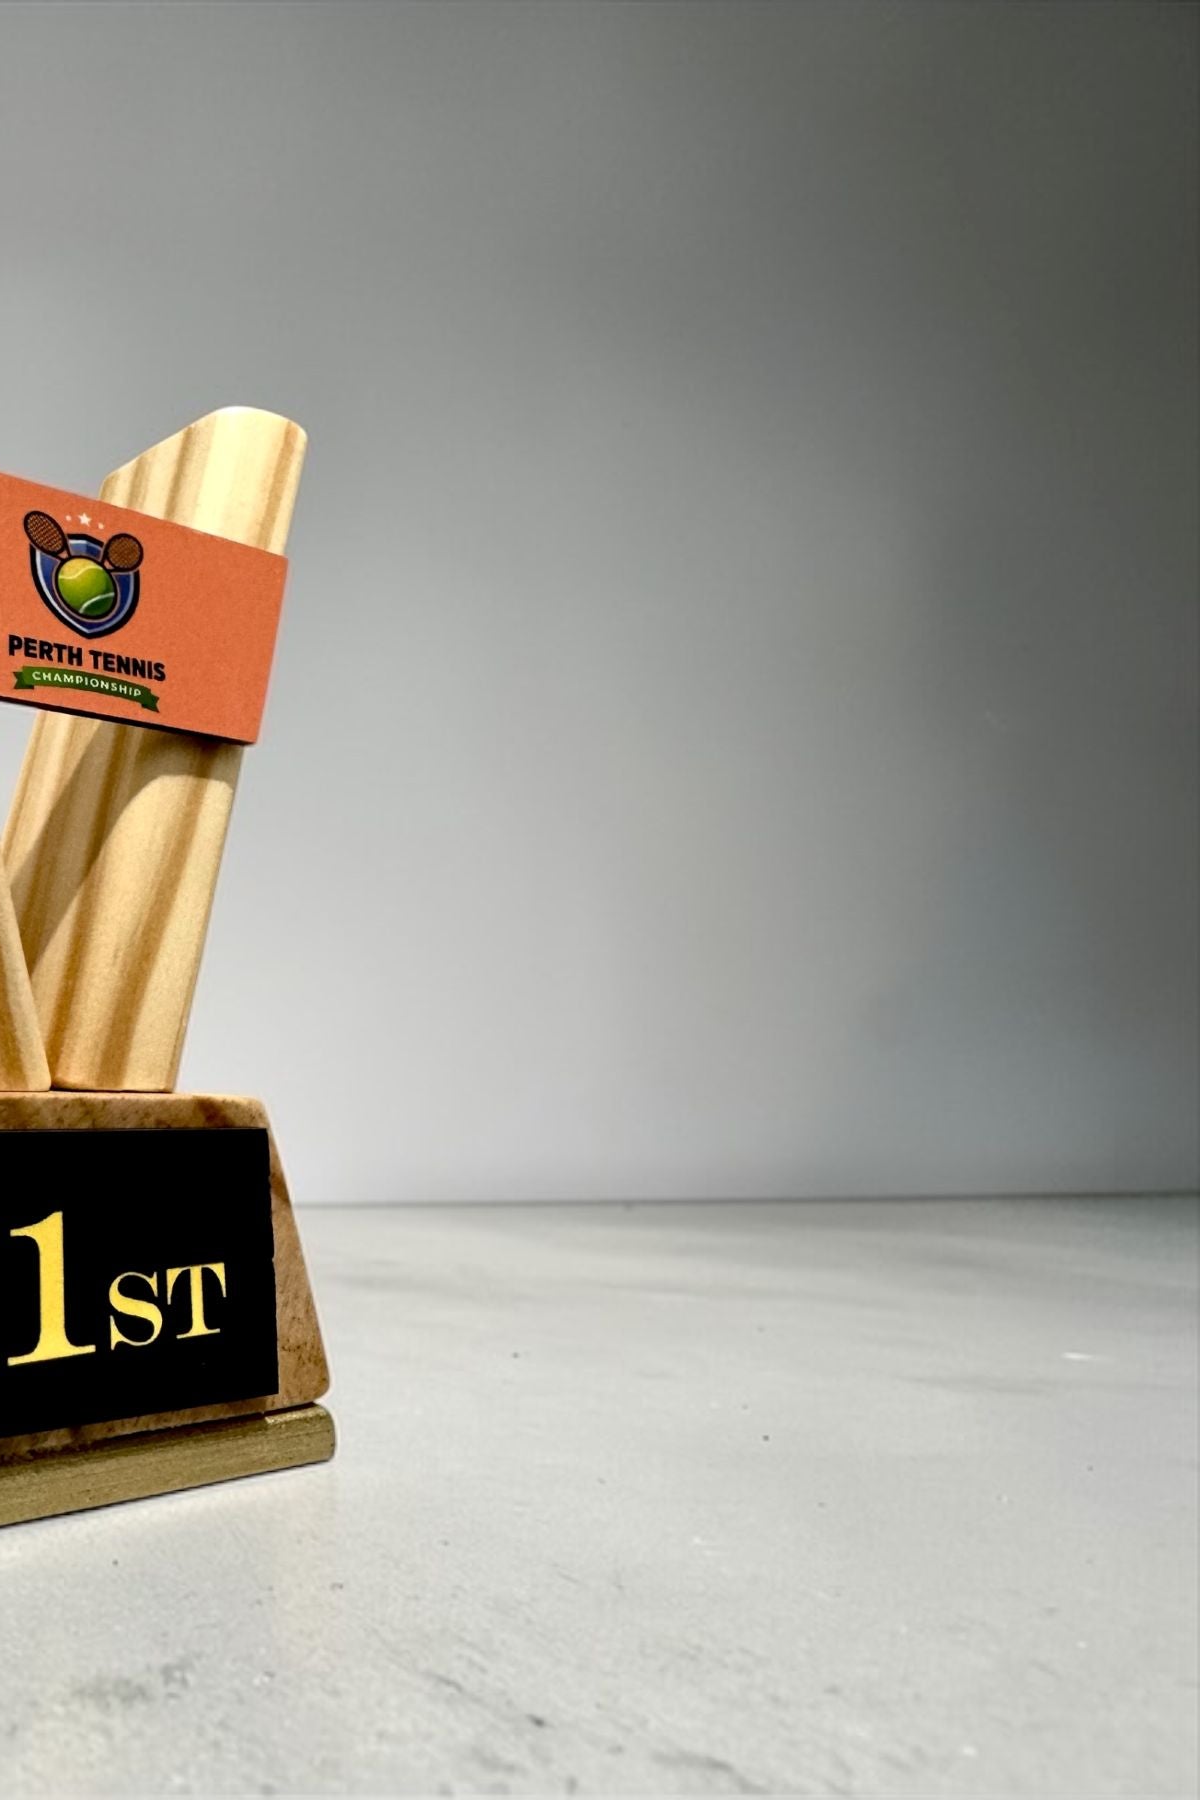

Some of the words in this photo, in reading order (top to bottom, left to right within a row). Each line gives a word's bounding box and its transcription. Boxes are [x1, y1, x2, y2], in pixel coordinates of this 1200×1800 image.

[8, 634, 83, 667] PERTH
[88, 649, 166, 682] TENNIS
[31, 671, 142, 697] CHAMPIONSHIP
[7, 1211, 227, 1367] 1ST
